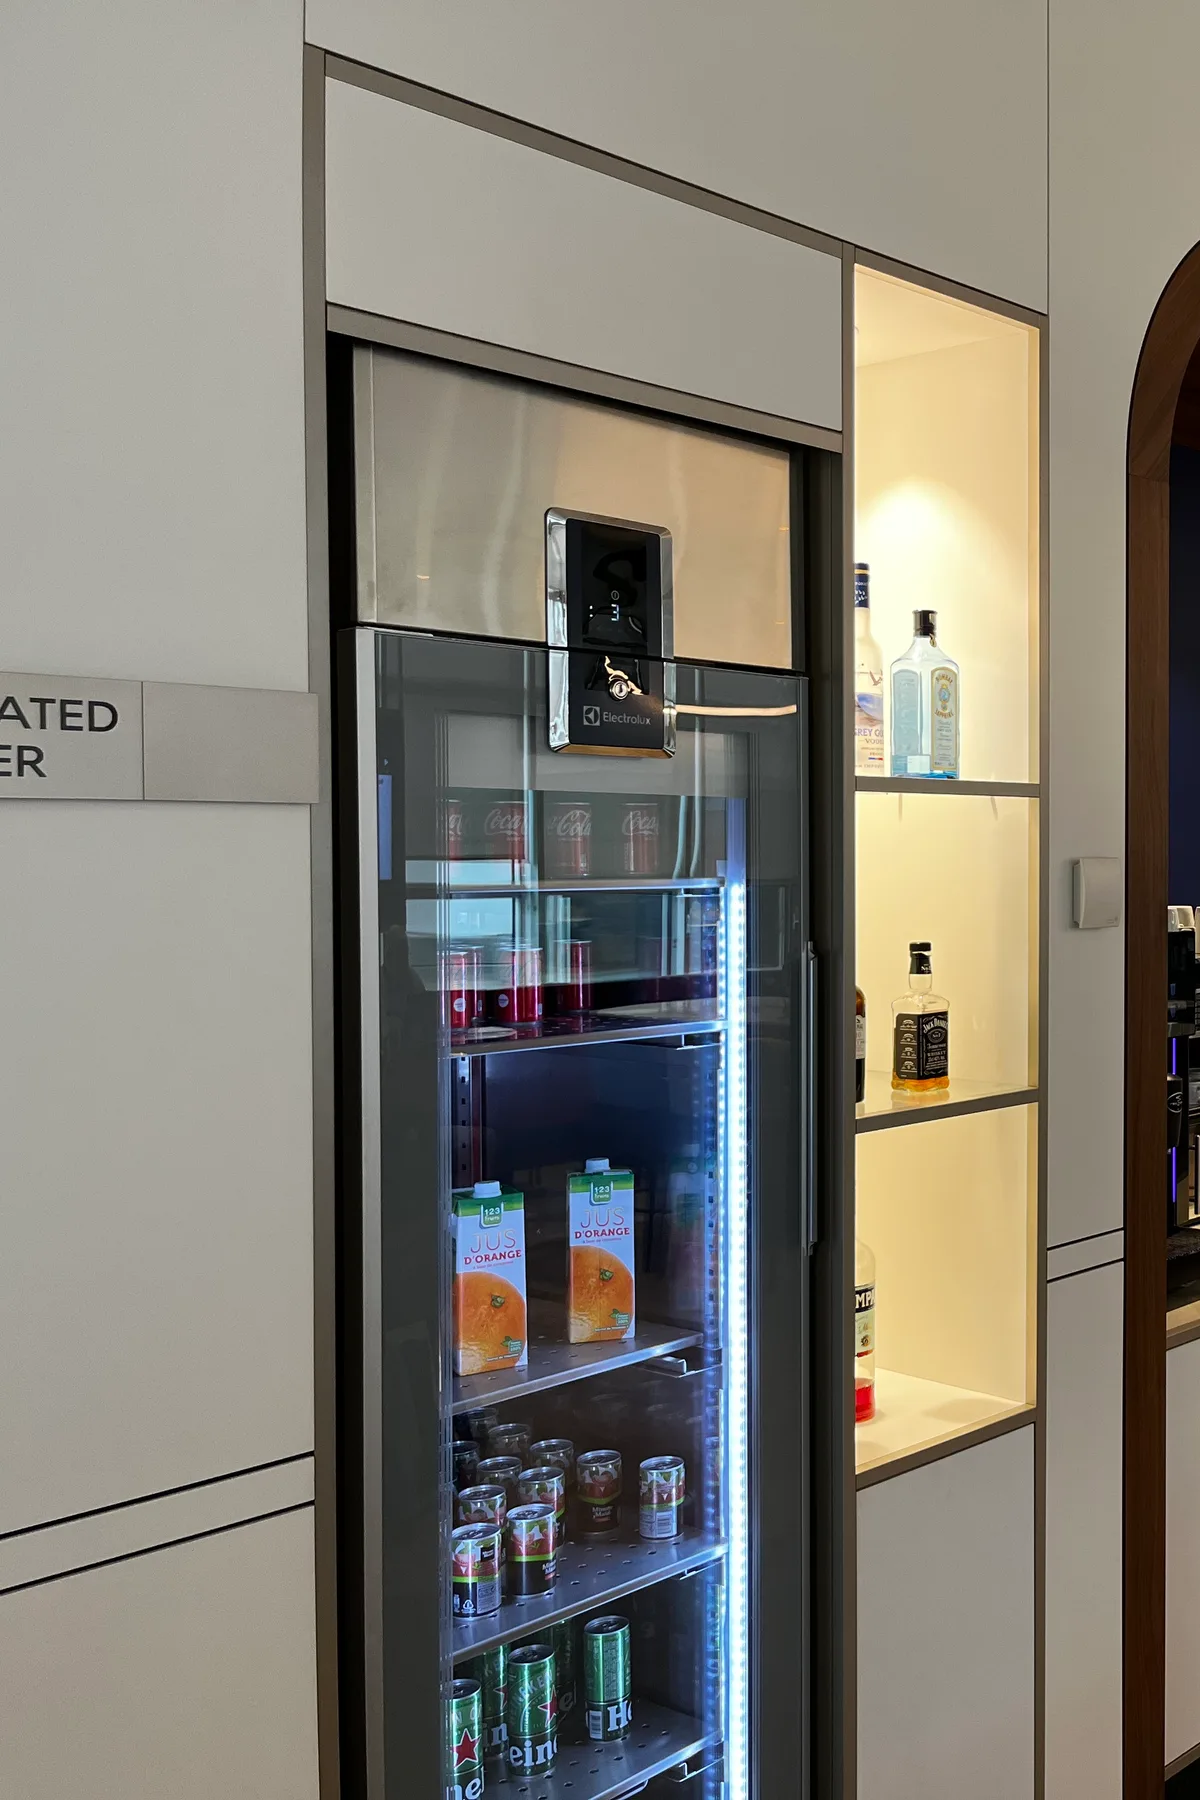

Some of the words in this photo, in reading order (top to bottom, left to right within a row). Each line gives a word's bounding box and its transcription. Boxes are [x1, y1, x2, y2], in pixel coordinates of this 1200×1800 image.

[0, 695, 119, 733] ATED
[603, 711, 652, 726] Electrolux
[594, 1185, 610, 1193] 123
[484, 1207, 501, 1215] 123
[580, 1207, 625, 1229] JUS
[574, 1227, 630, 1240] D'ORANGE
[470, 1229, 517, 1254] JUS
[463, 1249, 522, 1265] D'ORANGE
